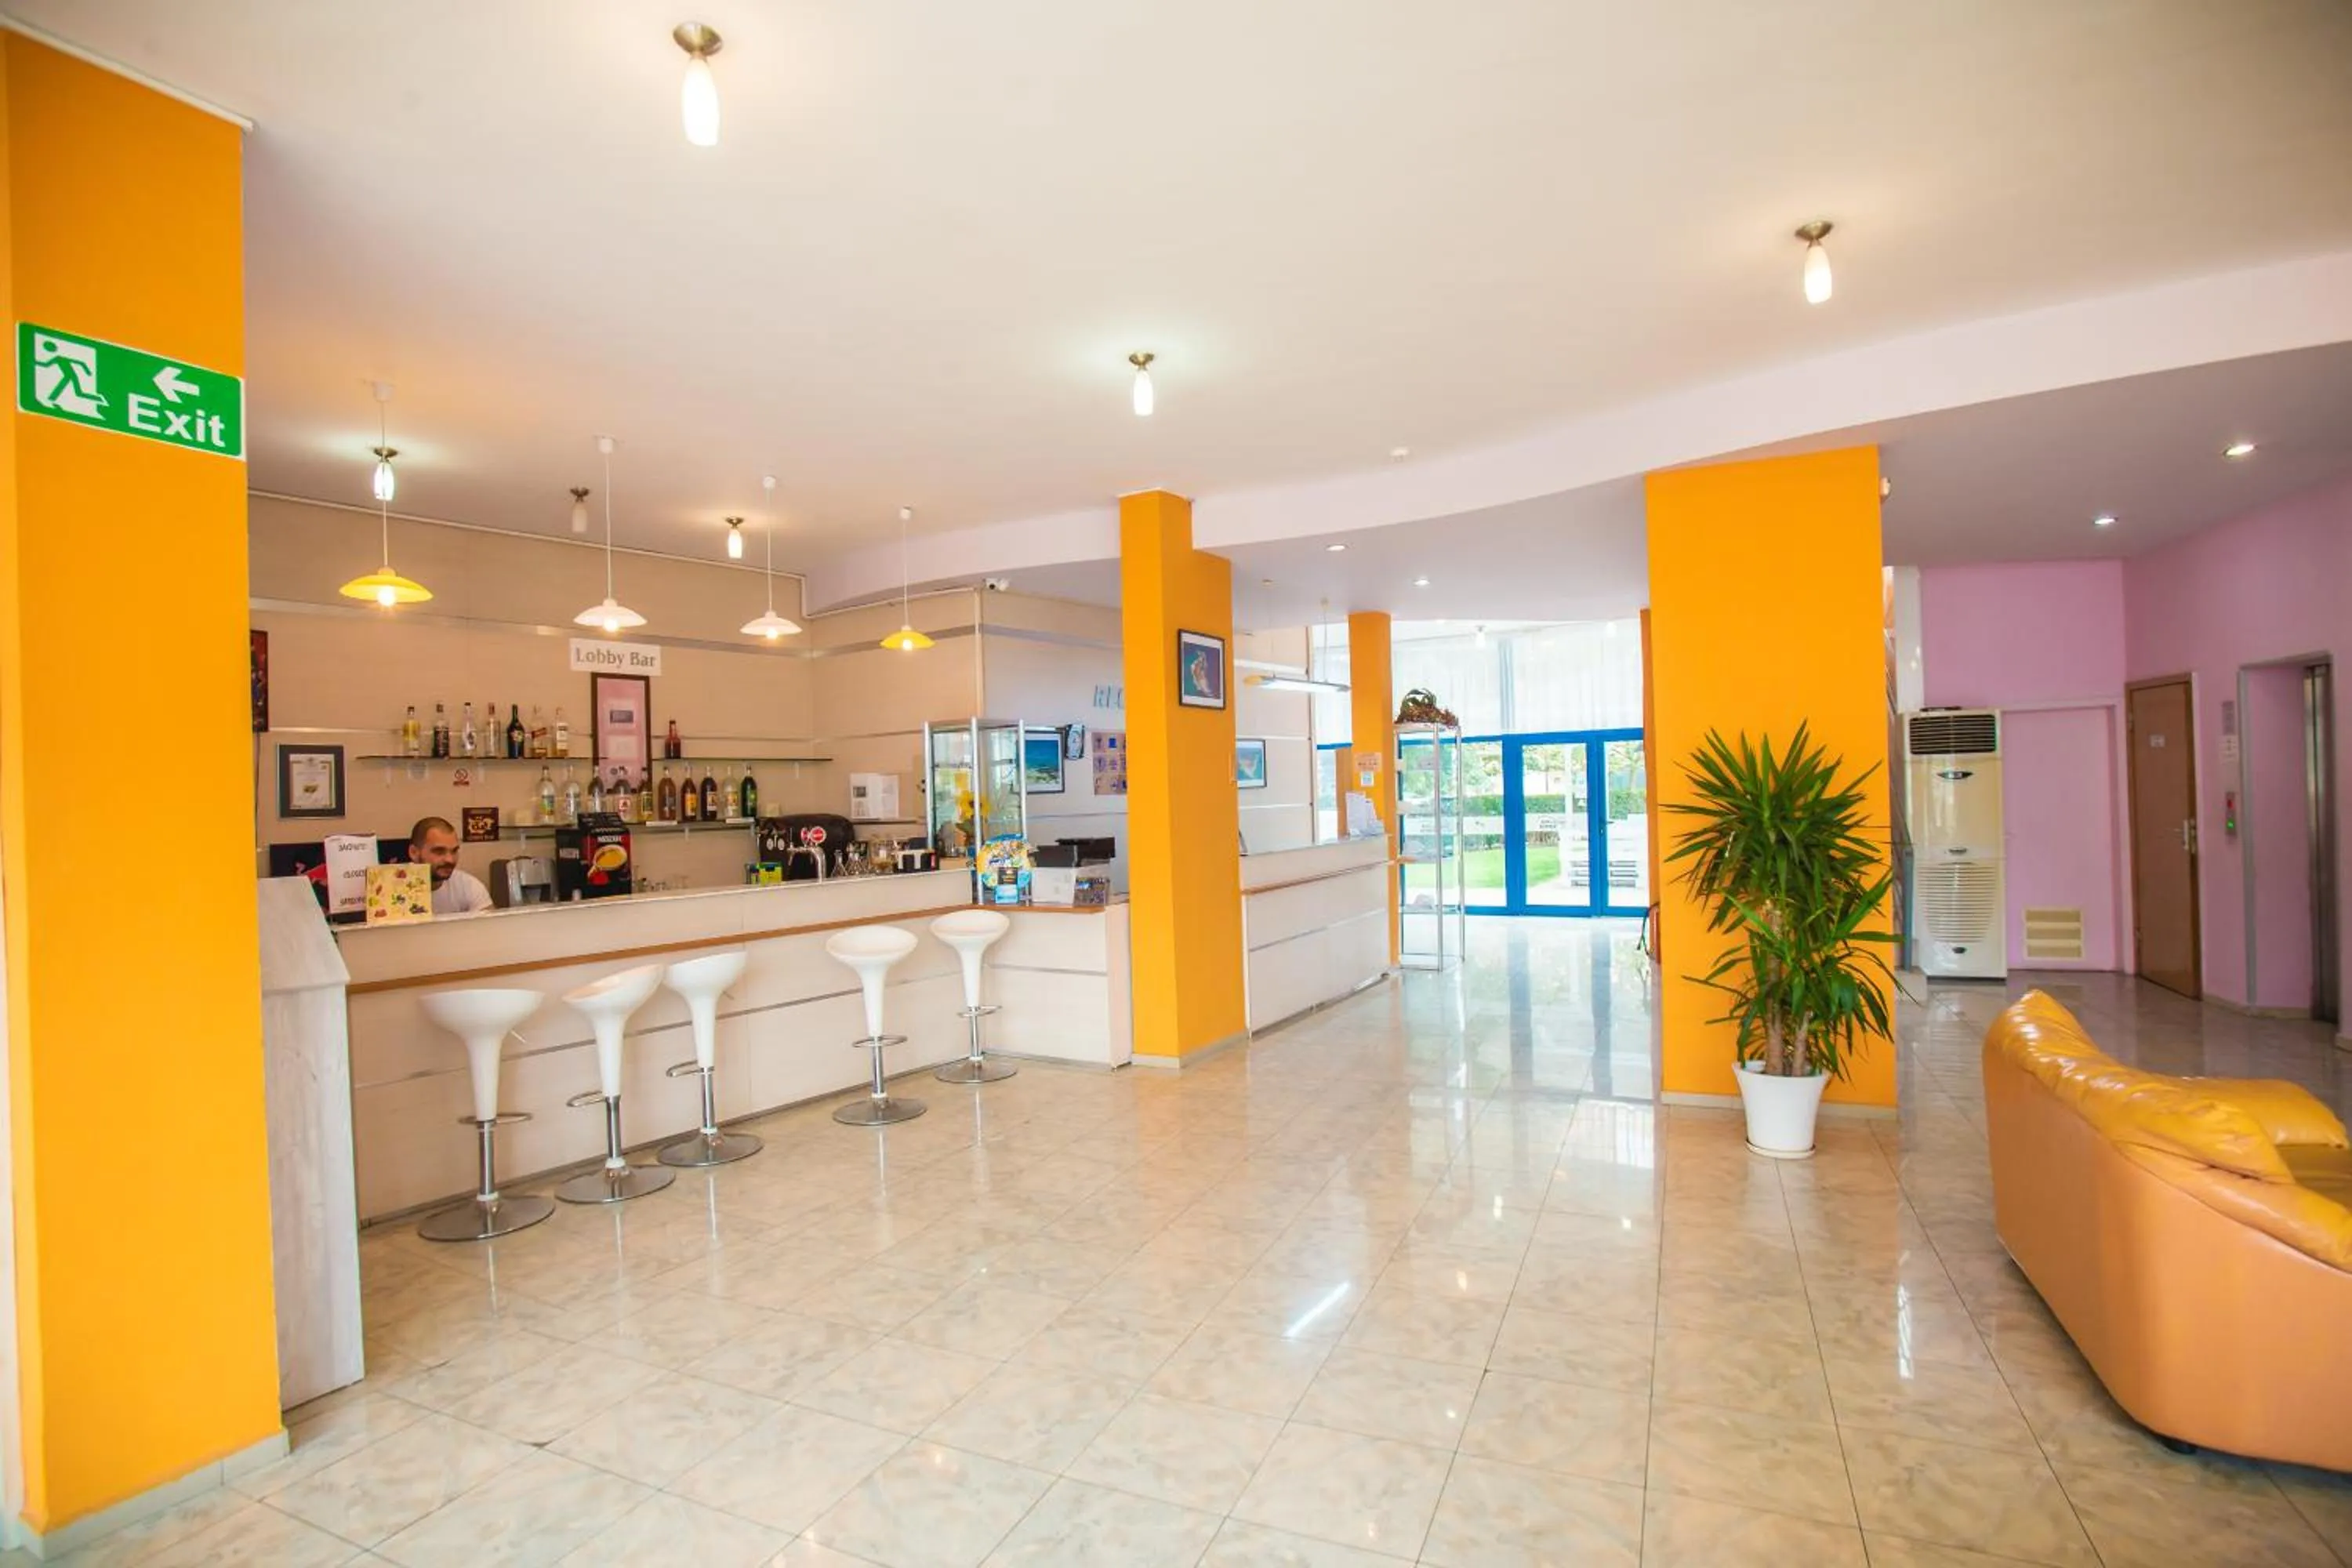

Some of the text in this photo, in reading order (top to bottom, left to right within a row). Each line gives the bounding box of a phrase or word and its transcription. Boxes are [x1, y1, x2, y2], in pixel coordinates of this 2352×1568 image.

[128, 393, 226, 448] Exit
[575, 647, 656, 669] Lobby Bar
